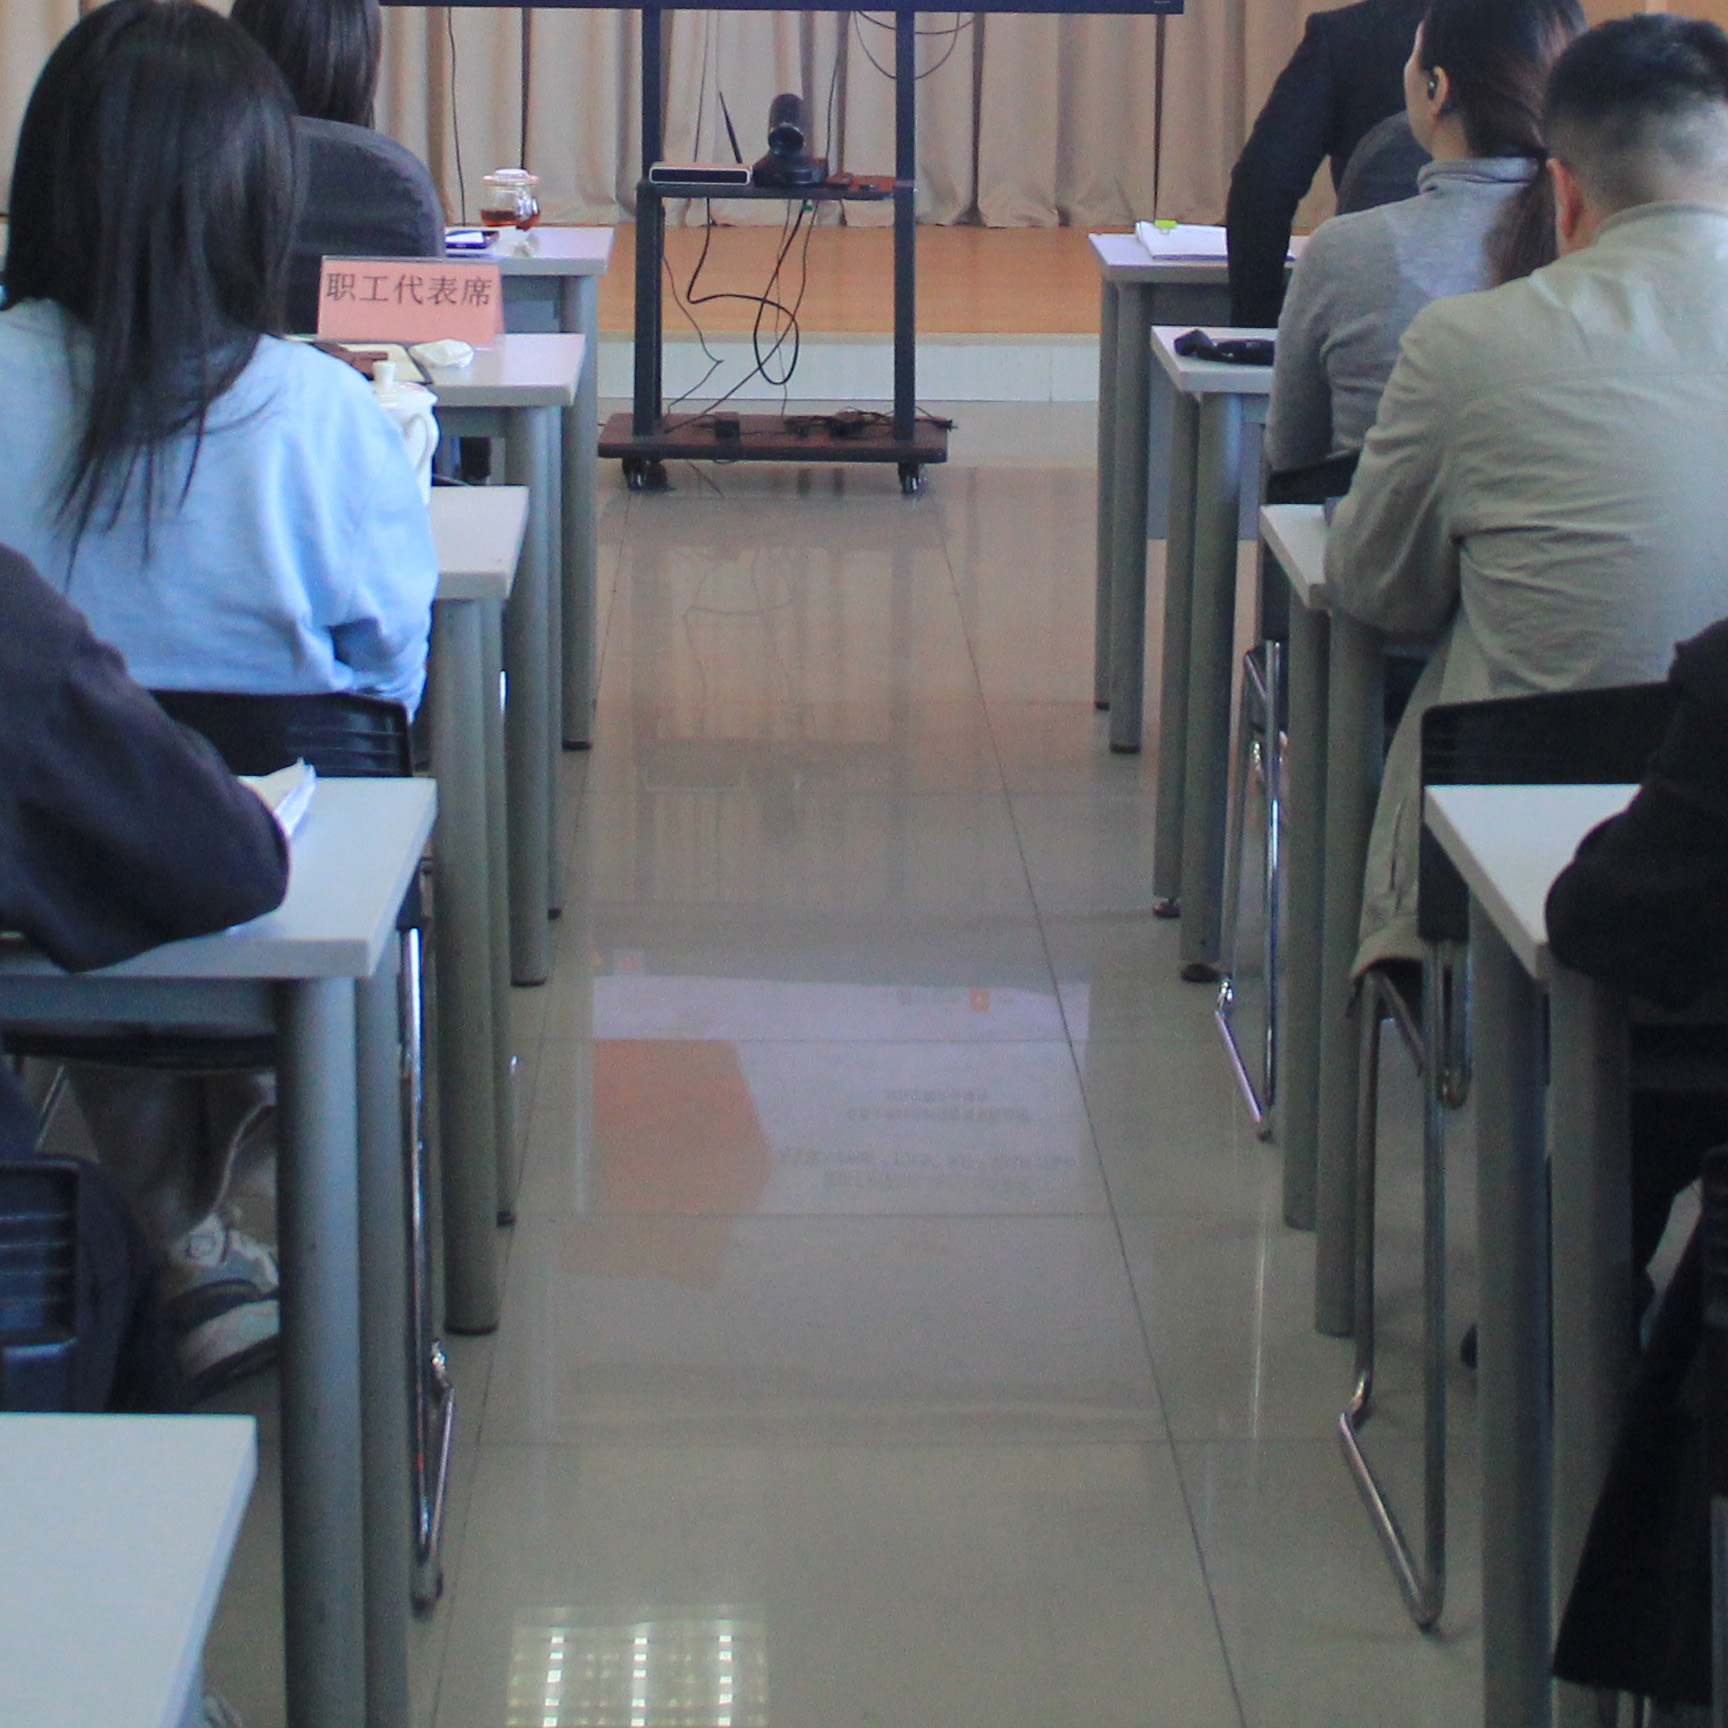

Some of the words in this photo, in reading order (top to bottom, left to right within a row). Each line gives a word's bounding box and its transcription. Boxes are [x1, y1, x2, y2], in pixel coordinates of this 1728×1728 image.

[325, 272, 493, 307] 职工代表席
